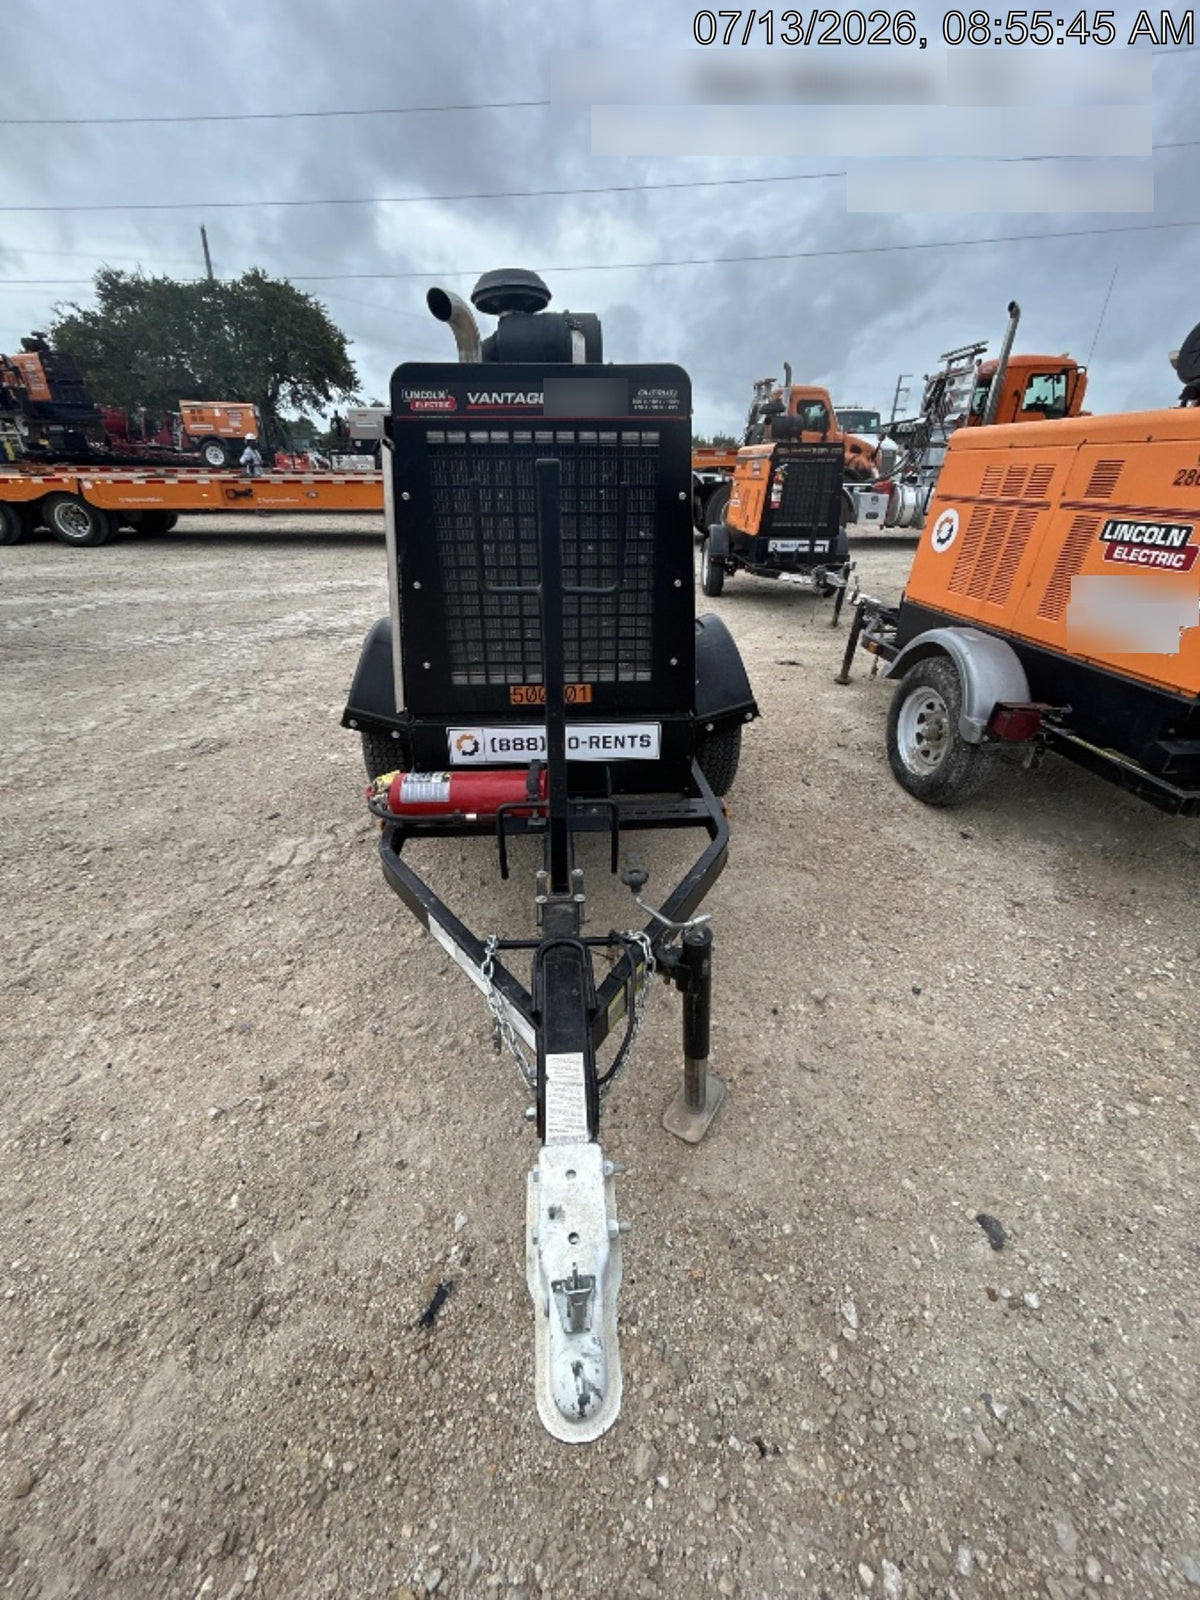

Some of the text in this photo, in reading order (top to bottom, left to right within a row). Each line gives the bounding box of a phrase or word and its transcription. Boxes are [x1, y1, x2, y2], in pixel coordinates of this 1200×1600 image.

[1103, 522, 1187, 547] LINCOLN
[1112, 546, 1186, 568] ELECTRIC
[512, 686, 586, 703] 50001
[490, 735, 546, 753] (888)
